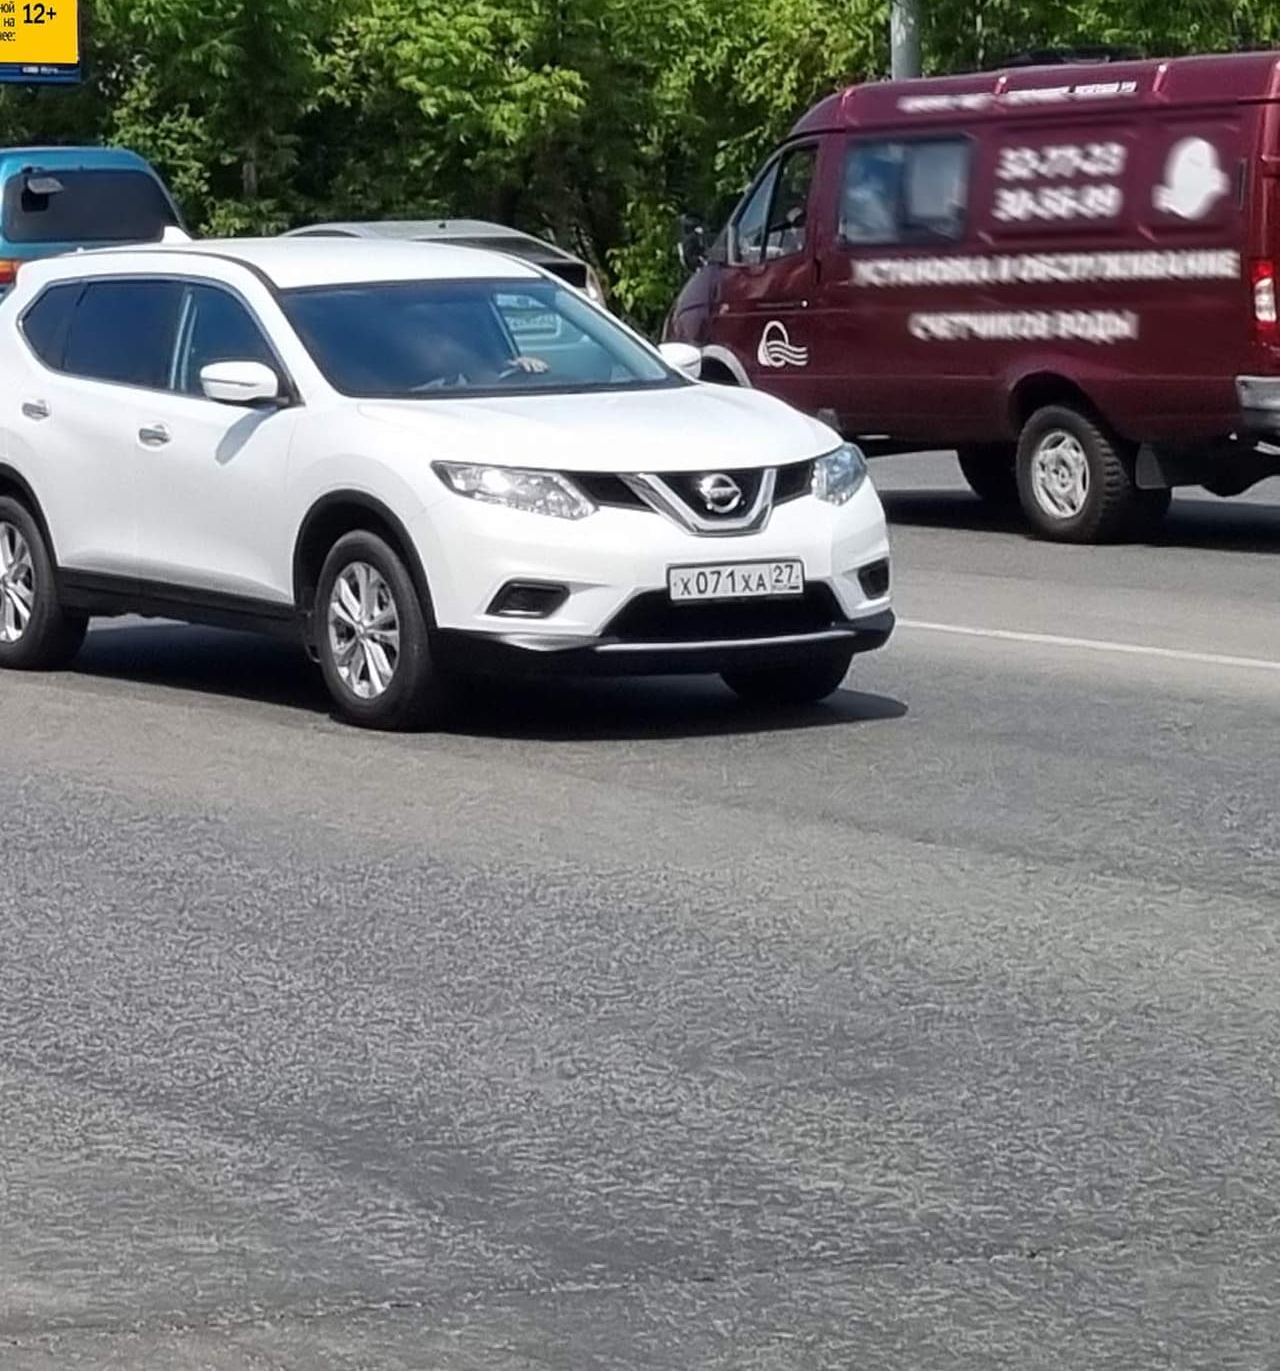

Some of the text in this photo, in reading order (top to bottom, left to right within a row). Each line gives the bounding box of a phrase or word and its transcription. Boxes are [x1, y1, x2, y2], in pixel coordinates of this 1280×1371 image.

[4, 17, 15, 27] на
[22, 3, 57, 24] 12+
[680, 564, 794, 596] Х071ХА 27
